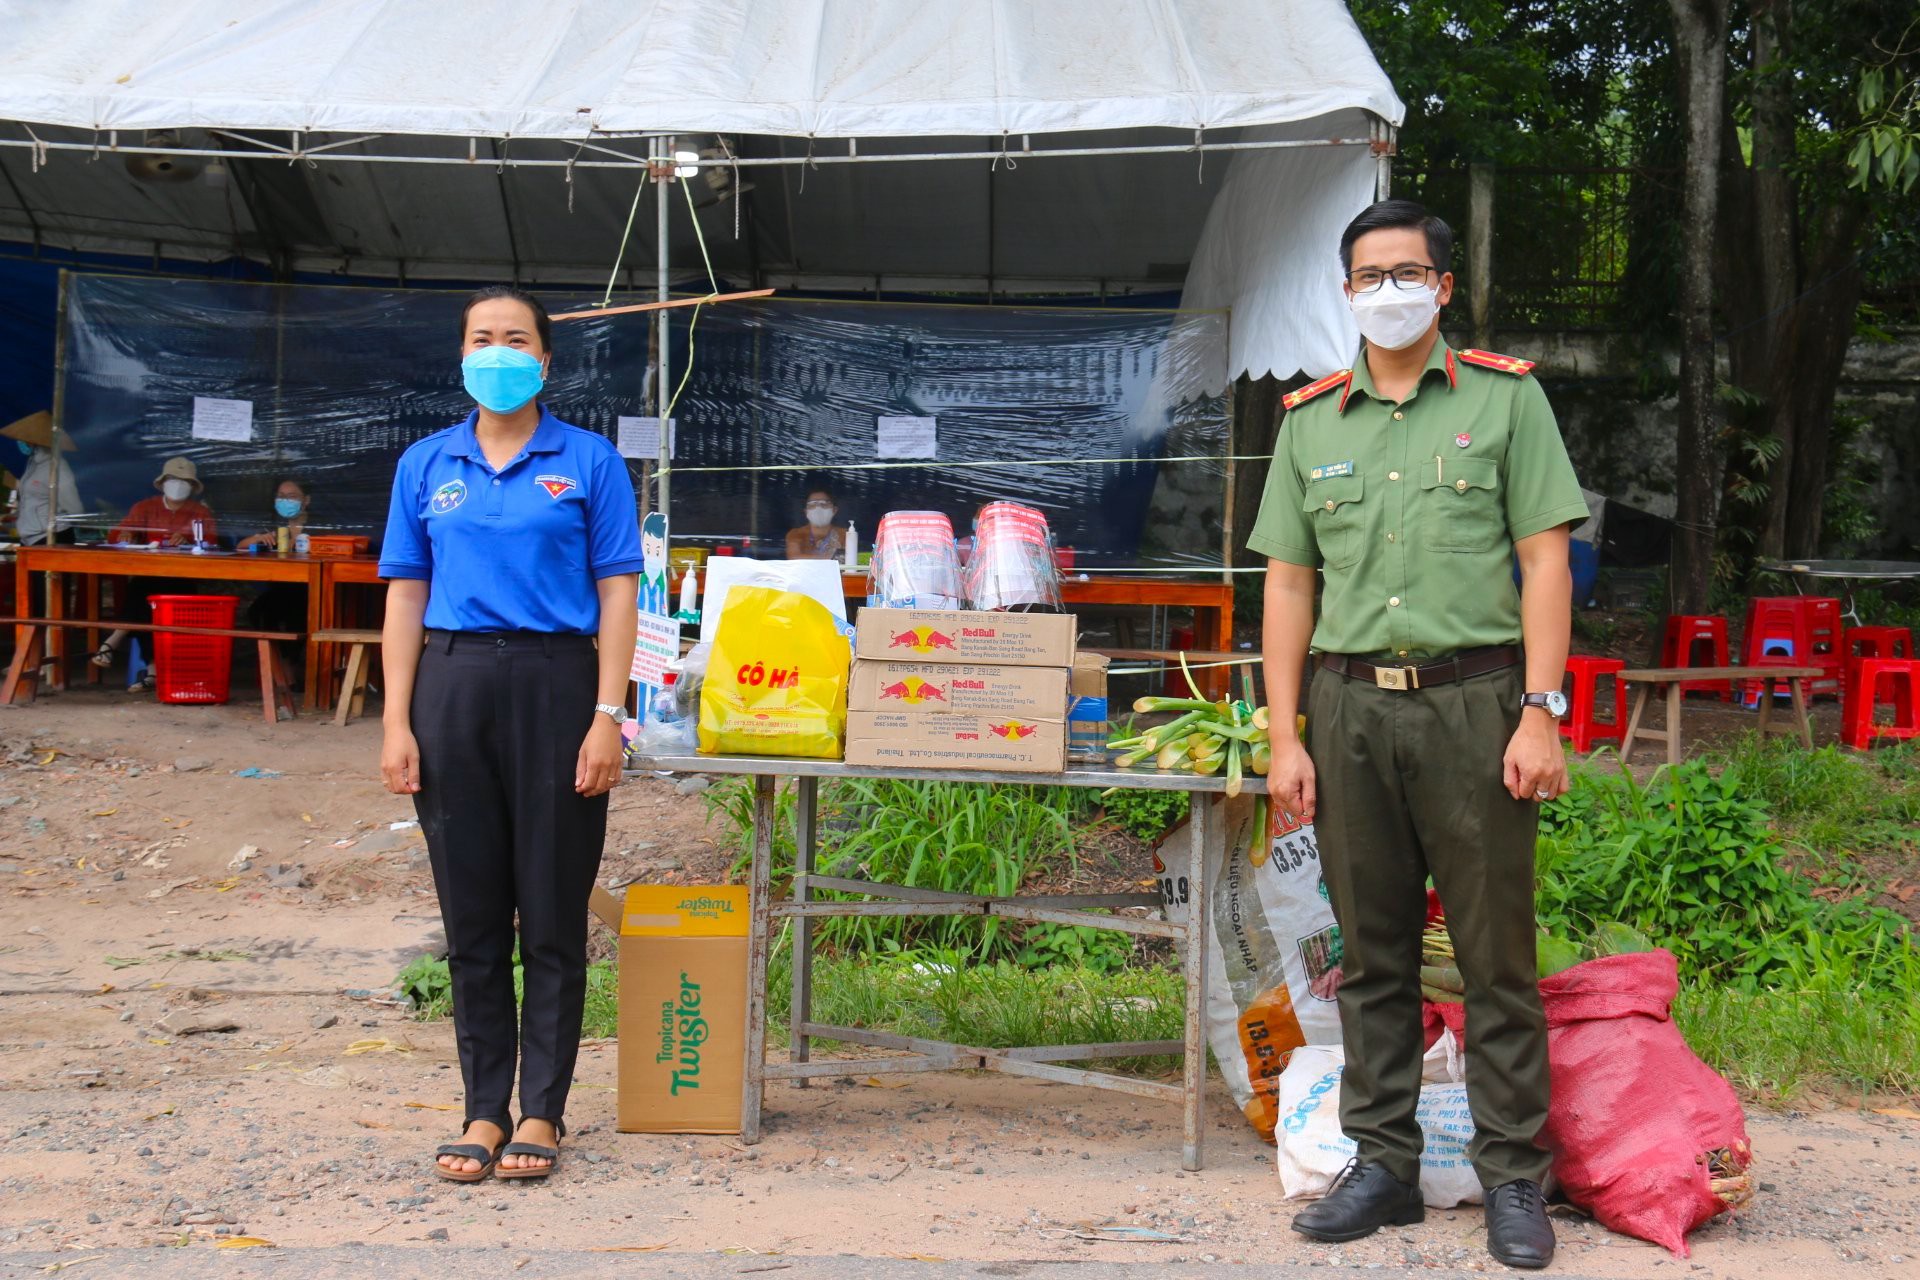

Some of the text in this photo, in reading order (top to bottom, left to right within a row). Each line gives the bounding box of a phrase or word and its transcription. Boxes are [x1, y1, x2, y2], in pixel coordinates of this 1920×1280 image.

[988, 615, 1000, 623] EXP
[737, 661, 765, 686] CÔ
[921, 665, 934, 674] MFD
[936, 666, 960, 674] 290621
[962, 667, 974, 675] EXP
[977, 668, 1000, 676] 291222
[876, 748, 904, 757] Thailand
[934, 750, 965, 759] Industries
[966, 752, 1016, 761] Pharmaceutical
[1227, 864, 1241, 890] LIỆU
[676, 897, 734, 913] Twister
[688, 910, 720, 920] Tropicana
[1230, 893, 1244, 936] NGOẠI
[1238, 939, 1258, 973] NHẬP
[656, 1000, 674, 1064] Tropicana
[670, 972, 709, 1097] Twister
[1443, 1124, 1460, 1132] FAX:
